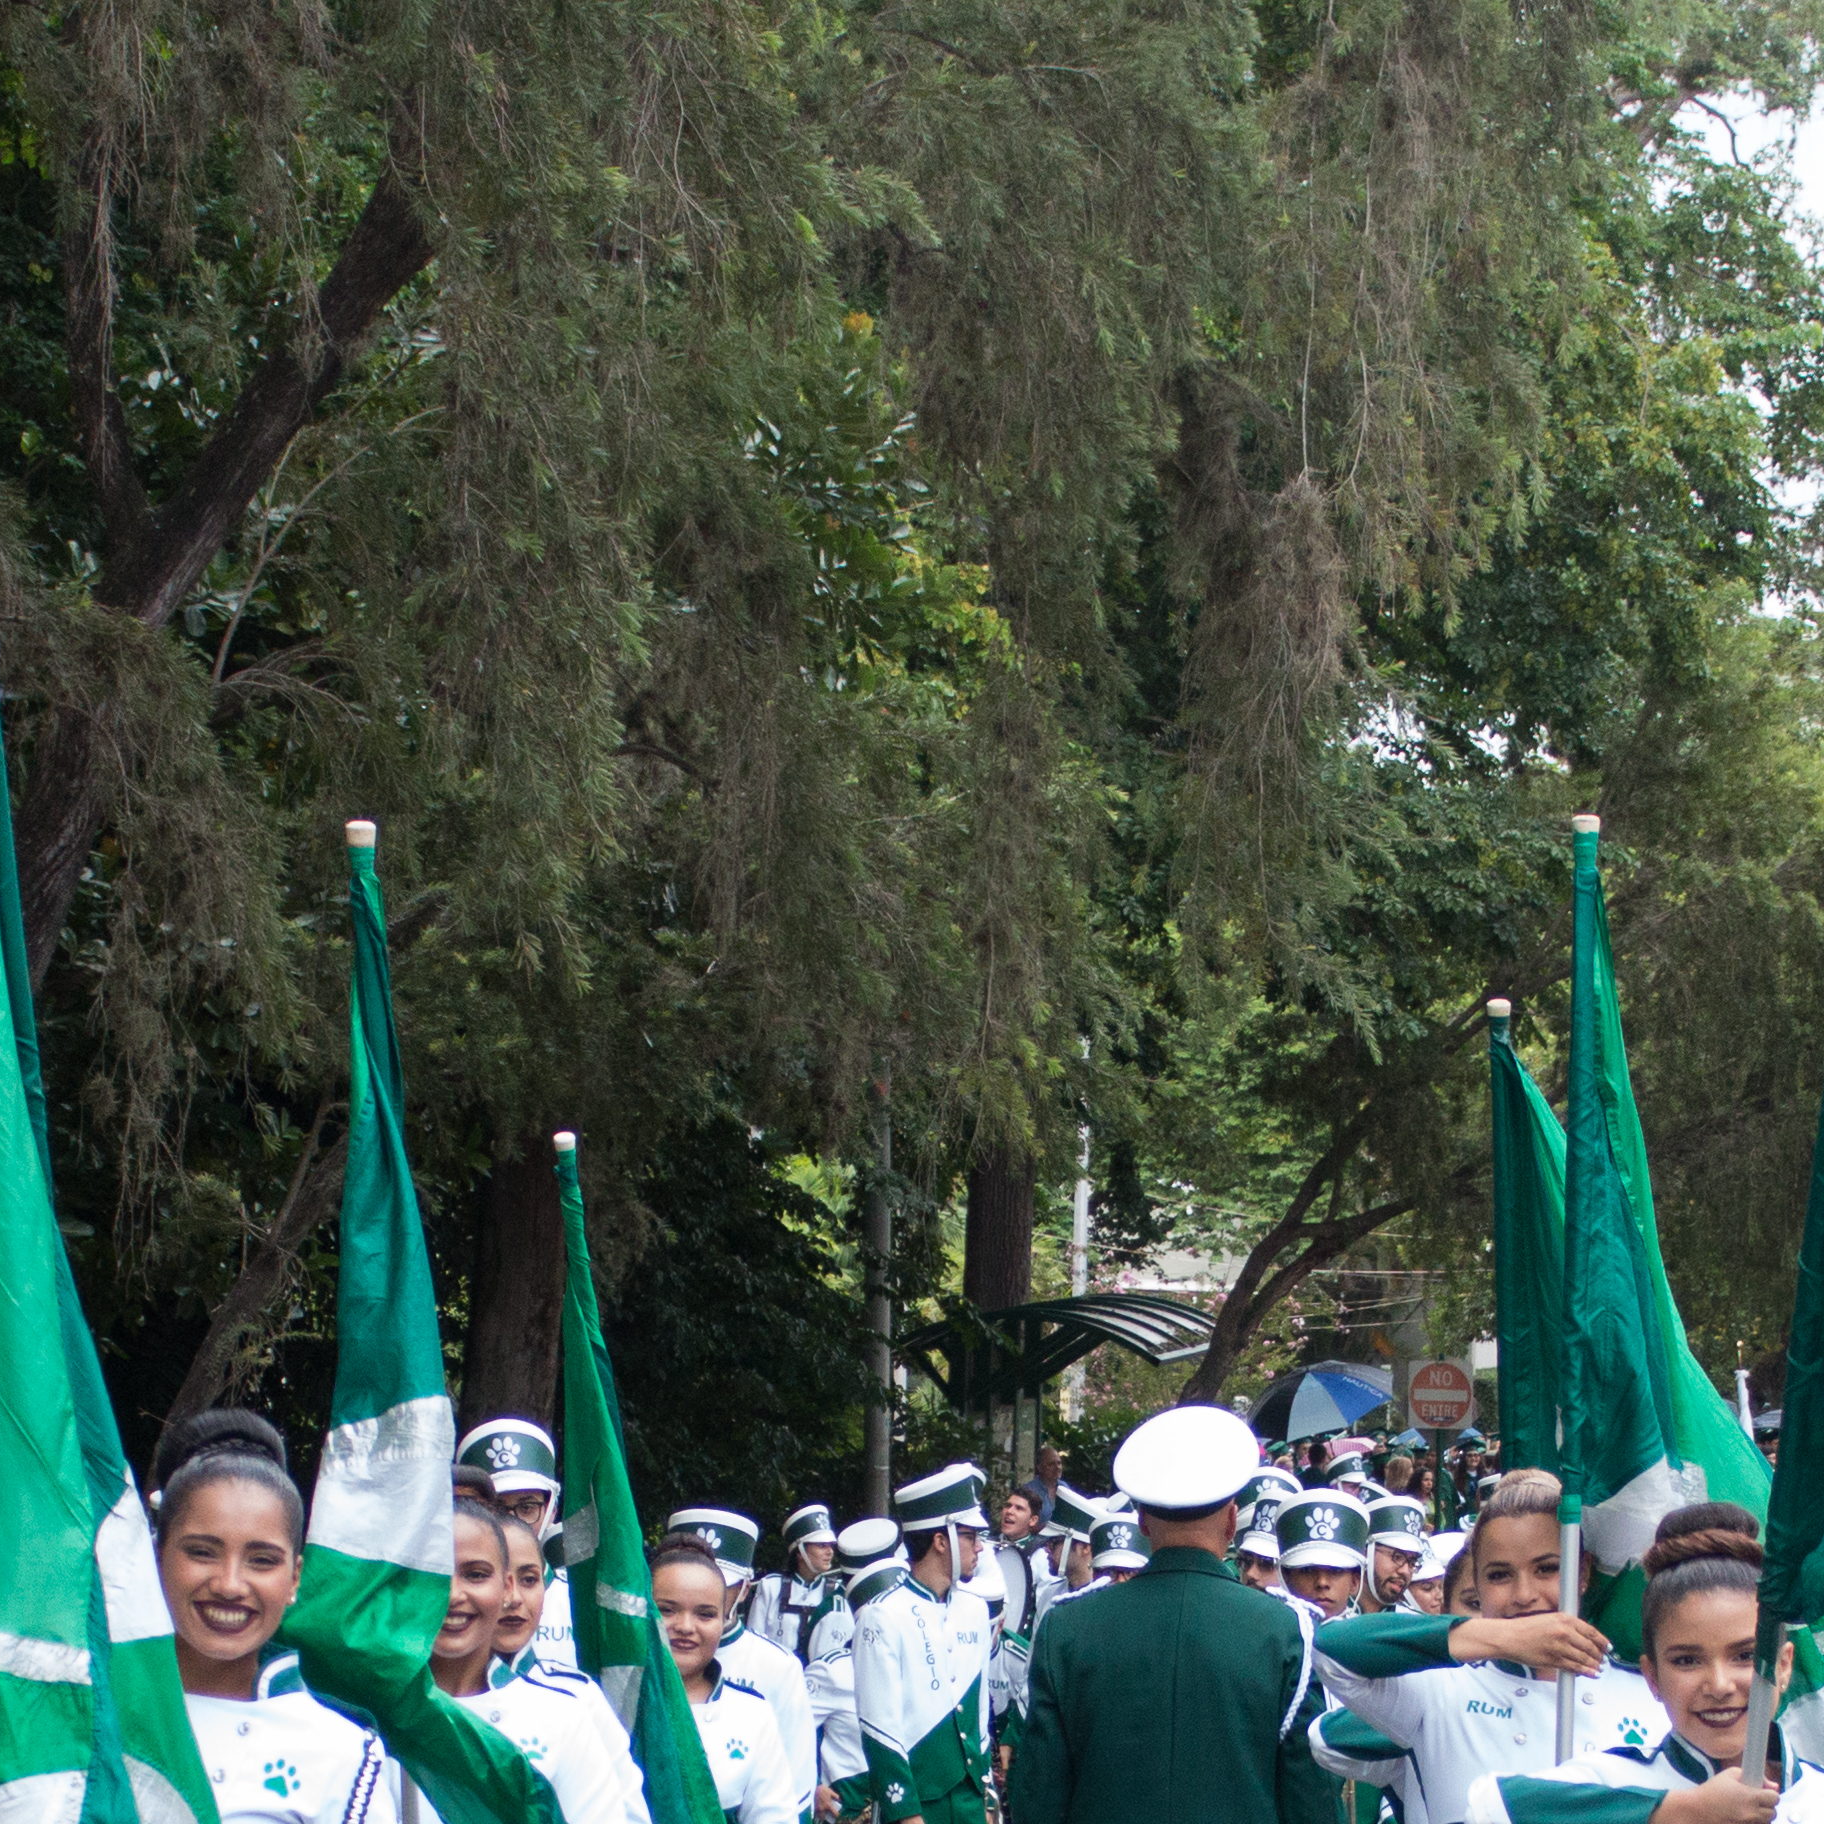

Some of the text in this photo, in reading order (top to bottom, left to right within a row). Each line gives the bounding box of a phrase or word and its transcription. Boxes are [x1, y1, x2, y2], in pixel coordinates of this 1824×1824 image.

[1430, 1370, 1453, 1386] NO
[1342, 1376, 1383, 1399] NAUTICA
[1422, 1403, 1458, 1417] ENTRE
[1316, 1525, 1327, 1536] C
[911, 1605, 940, 1691] COLEGIO
[1466, 1700, 1513, 1719] RUM
